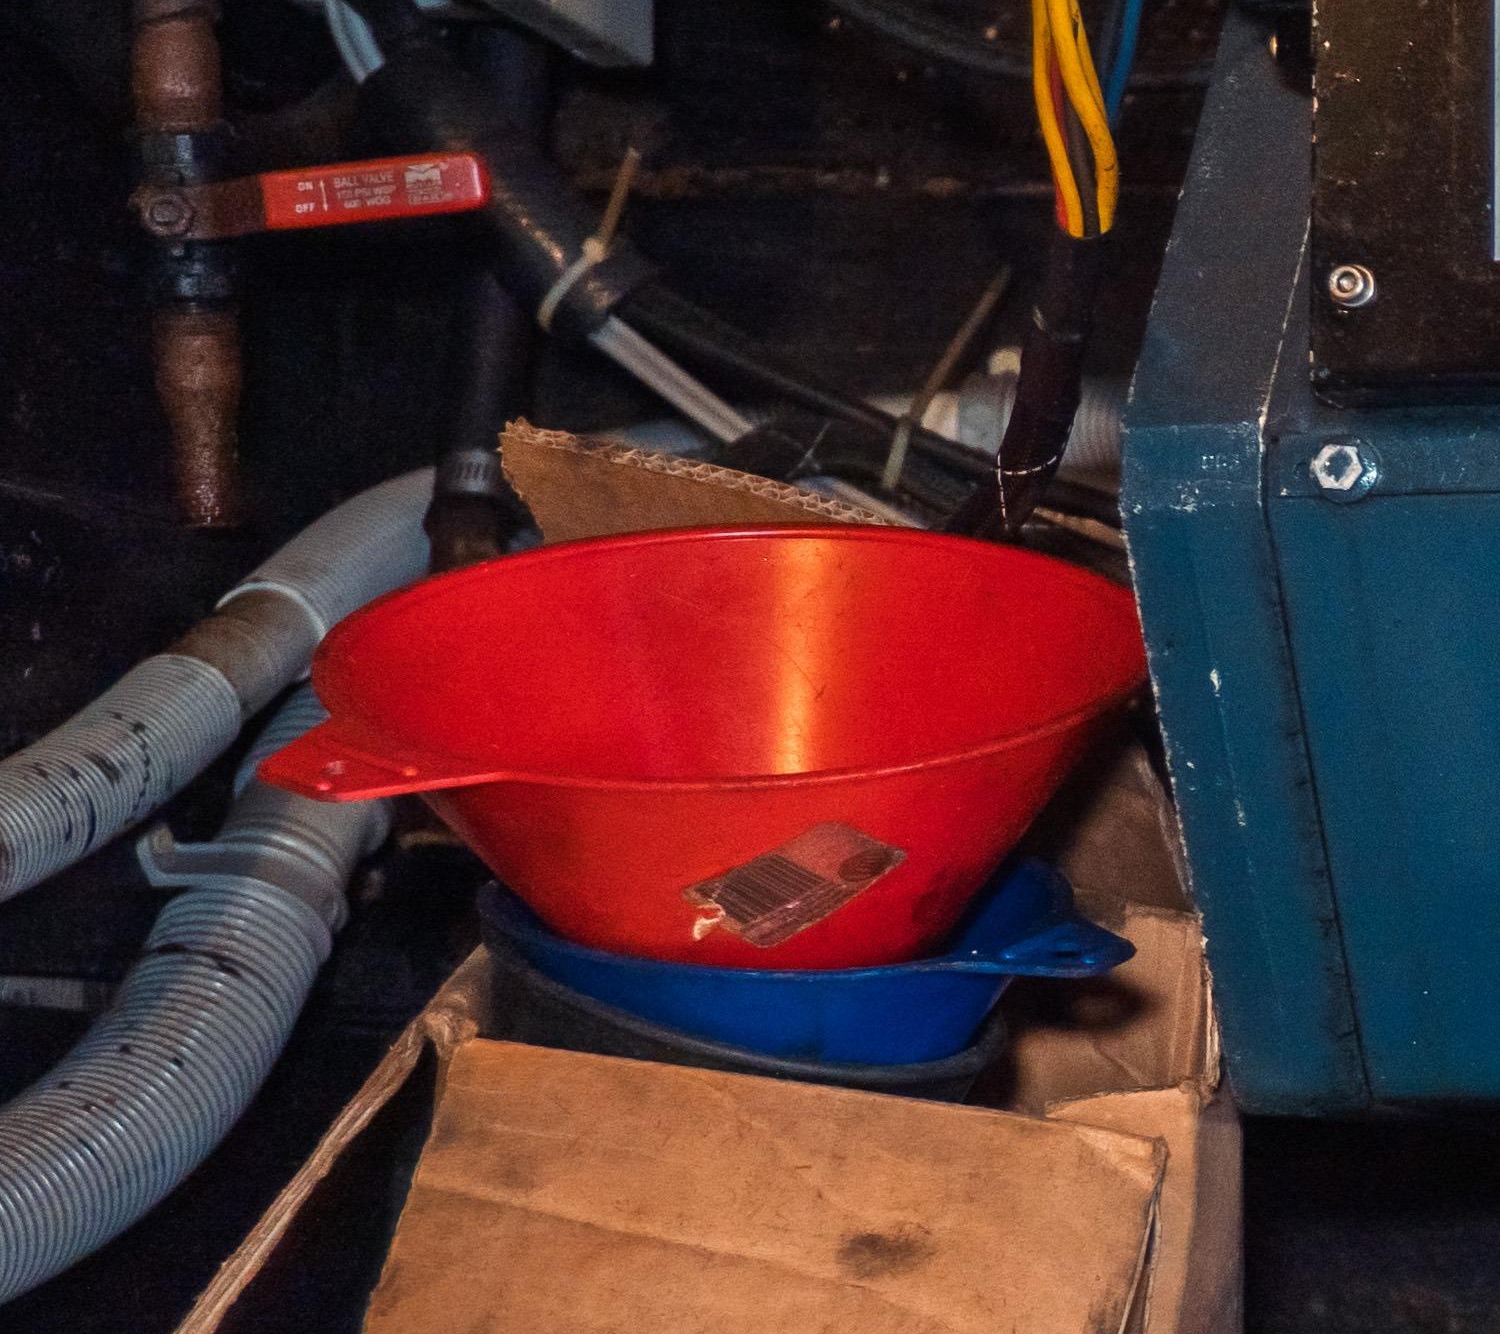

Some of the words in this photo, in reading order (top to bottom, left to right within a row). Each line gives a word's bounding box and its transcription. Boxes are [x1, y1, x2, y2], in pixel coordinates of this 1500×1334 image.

[333, 177, 358, 188] BALL
[362, 171, 394, 185] VALVE
[298, 182, 313, 191] ON
[296, 203, 315, 214] OFF
